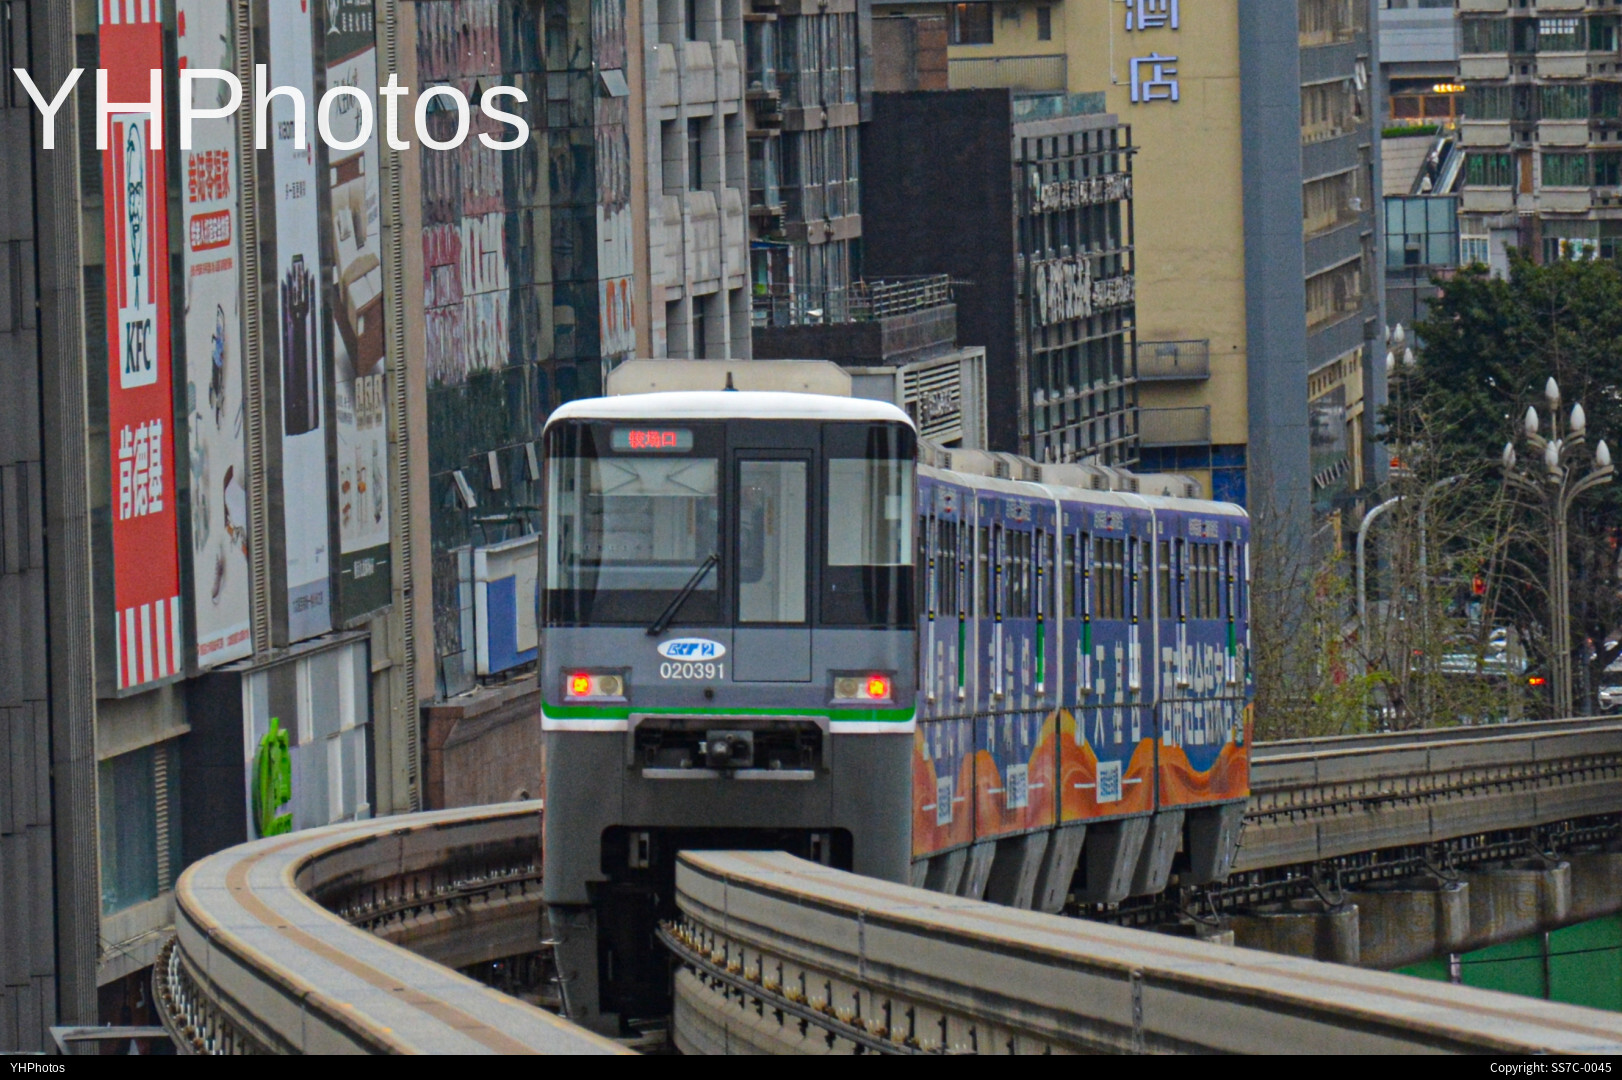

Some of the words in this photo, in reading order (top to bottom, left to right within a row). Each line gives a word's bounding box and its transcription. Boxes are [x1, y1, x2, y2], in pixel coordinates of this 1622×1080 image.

[125, 318, 152, 374] KFC
[628, 429, 677, 449] 较场口
[118, 418, 163, 520] 肯德基
[660, 662, 724, 679] 020391
